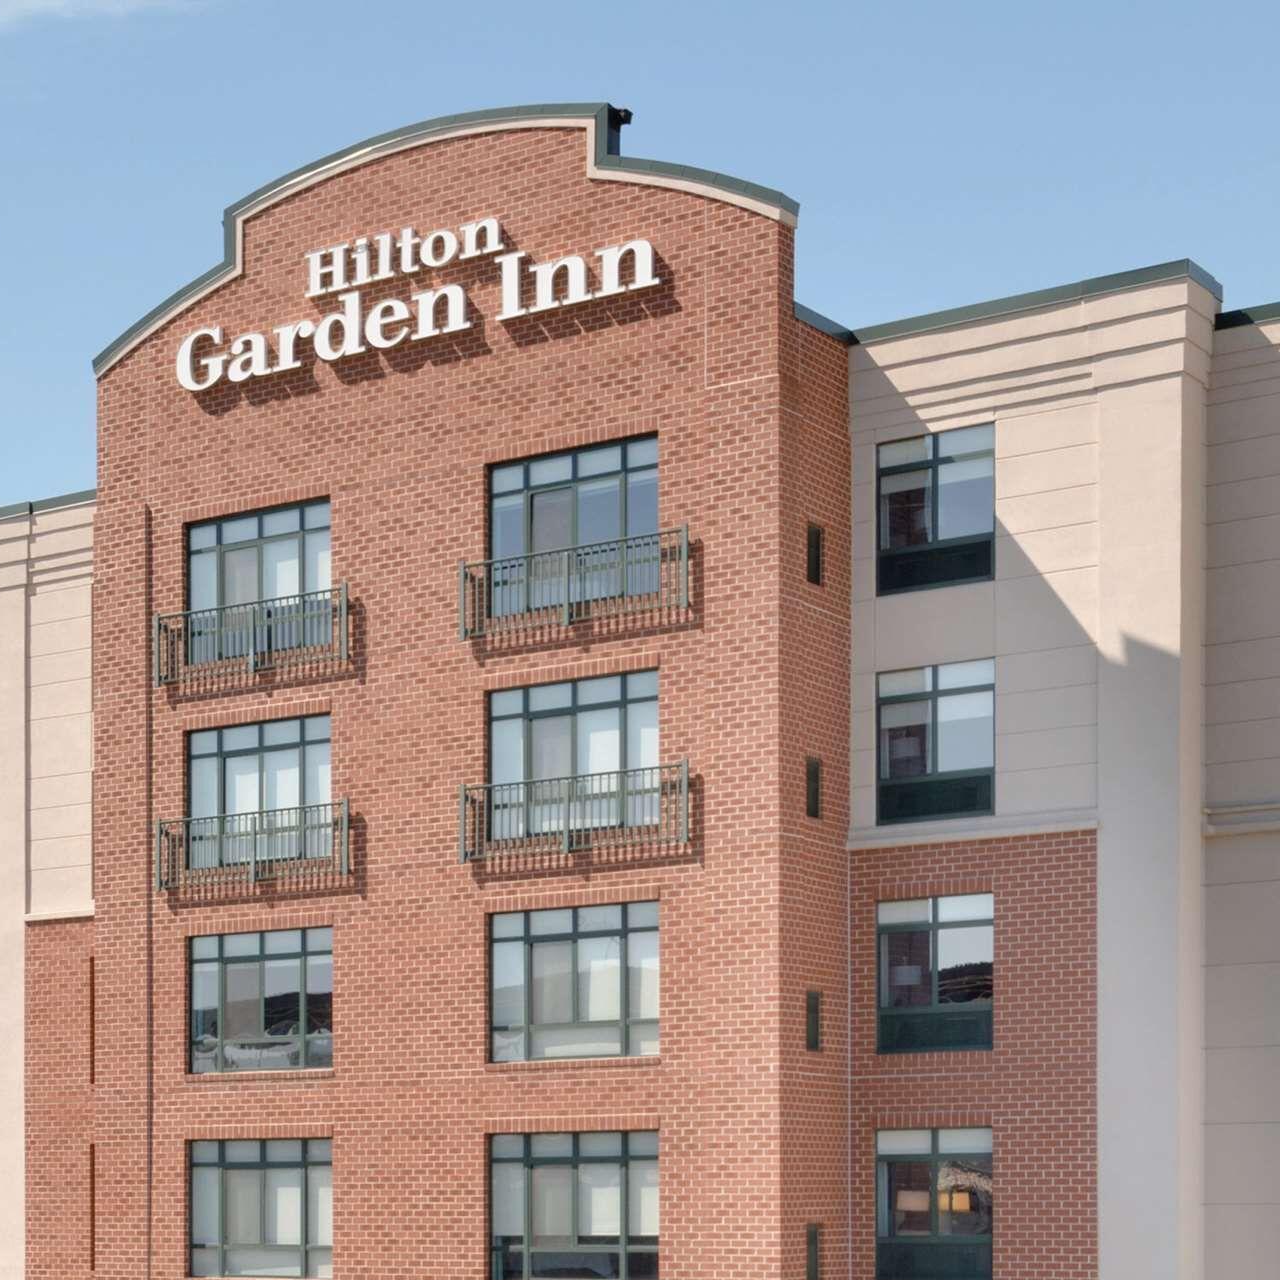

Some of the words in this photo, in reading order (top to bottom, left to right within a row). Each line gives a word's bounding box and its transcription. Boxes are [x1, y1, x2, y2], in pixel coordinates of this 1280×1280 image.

[176, 282, 471, 392] Garden
[494, 237, 660, 322] Inn
[304, 217, 504, 298] Hilton
